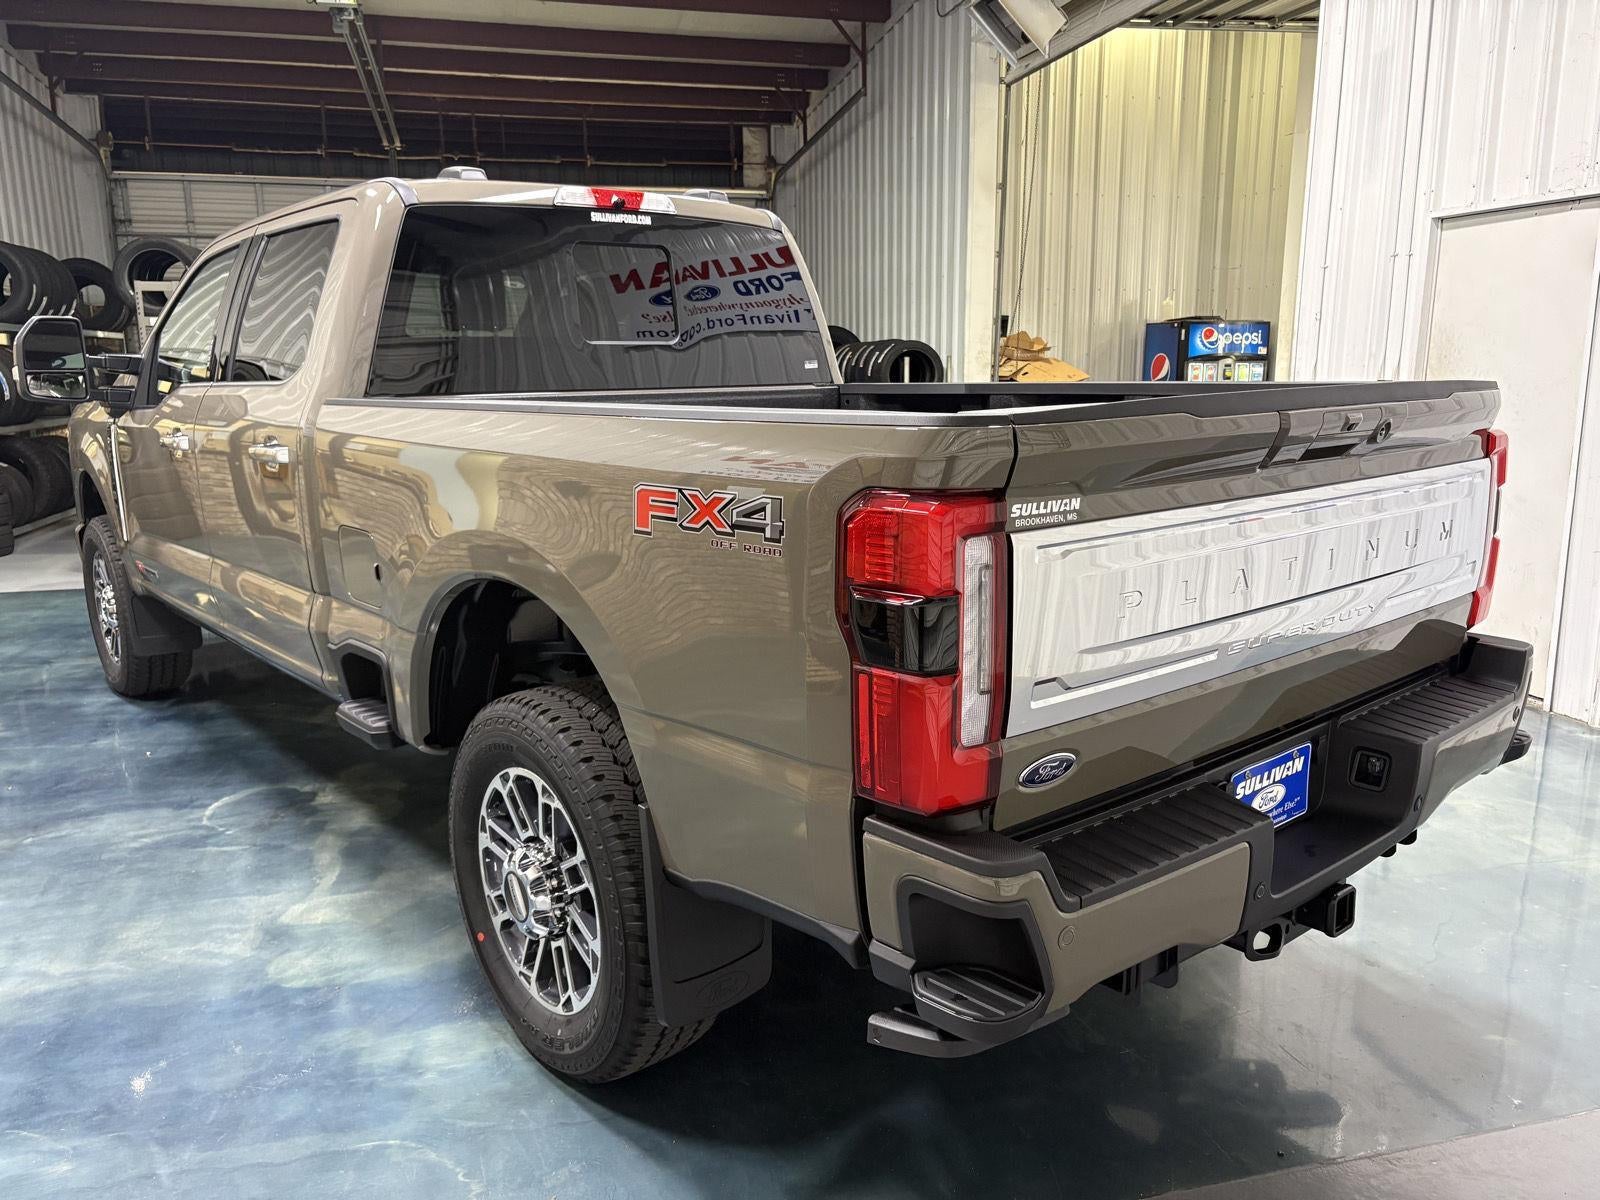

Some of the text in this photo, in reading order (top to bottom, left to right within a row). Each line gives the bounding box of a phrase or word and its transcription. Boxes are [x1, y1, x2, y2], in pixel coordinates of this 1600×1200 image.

[591, 211, 652, 226] SULLIVANFORD.COM
[1218, 330, 1262, 354] pepsi
[633, 482, 785, 544] FX4
[1010, 498, 1080, 517] SULLIVAN
[1015, 512, 1078, 527] BROOKHAVEN, MS
[711, 539, 782, 557] OFF ROAD
[1118, 519, 1453, 618] PLATINUM
[1035, 760, 1067, 782] Ford
[1235, 756, 1305, 800] SULLIVAN
[1258, 788, 1280, 809] Ford
